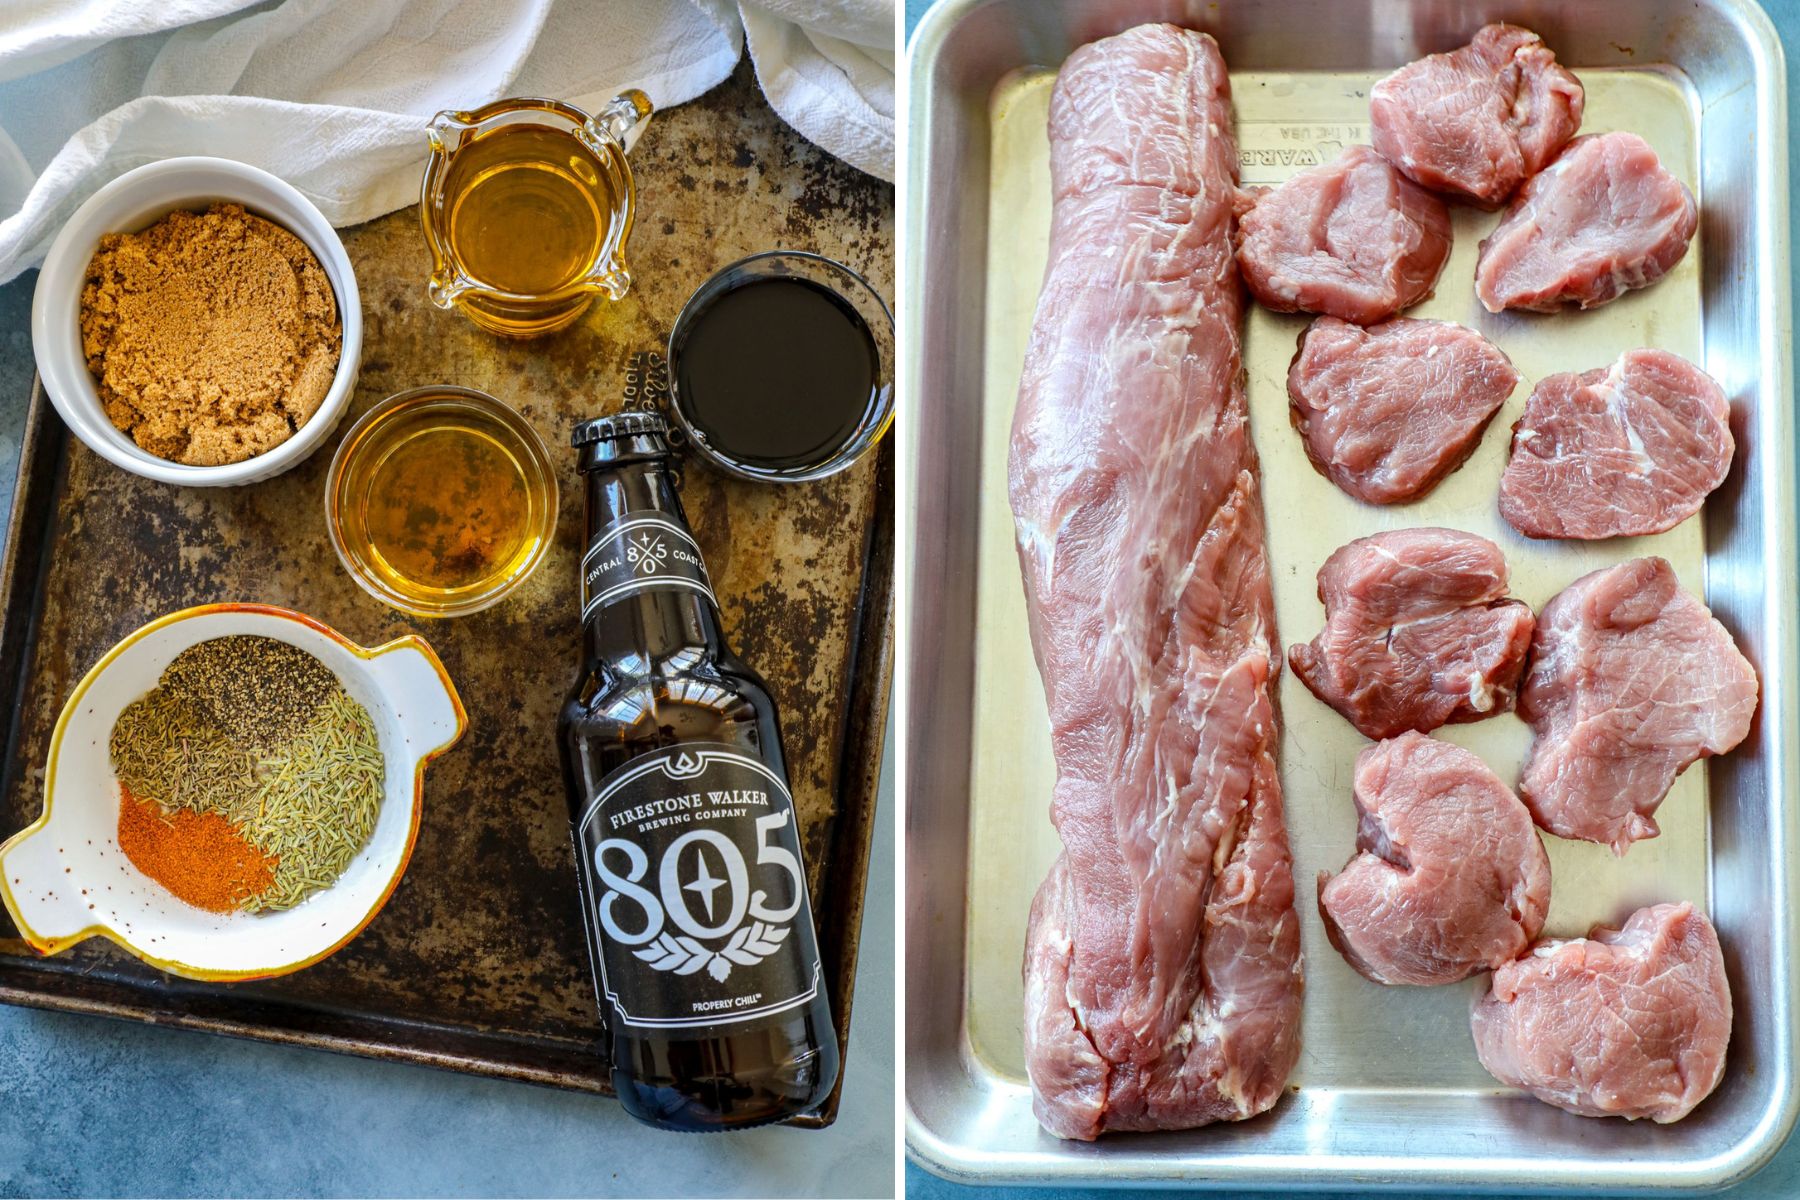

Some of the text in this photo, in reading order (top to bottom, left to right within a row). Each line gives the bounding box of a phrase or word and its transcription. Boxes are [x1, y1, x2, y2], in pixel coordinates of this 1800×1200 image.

[1279, 127, 1311, 140] USA
[1240, 149, 1318, 166] WARE
[586, 557, 622, 586] CENTRAL
[673, 550, 698, 566] COAST
[610, 790, 769, 829] FIRESTONE WALKER
[638, 808, 748, 833] BREWING COMPANY
[594, 808, 802, 945] 805
[692, 999, 733, 1012] PROPERLY
